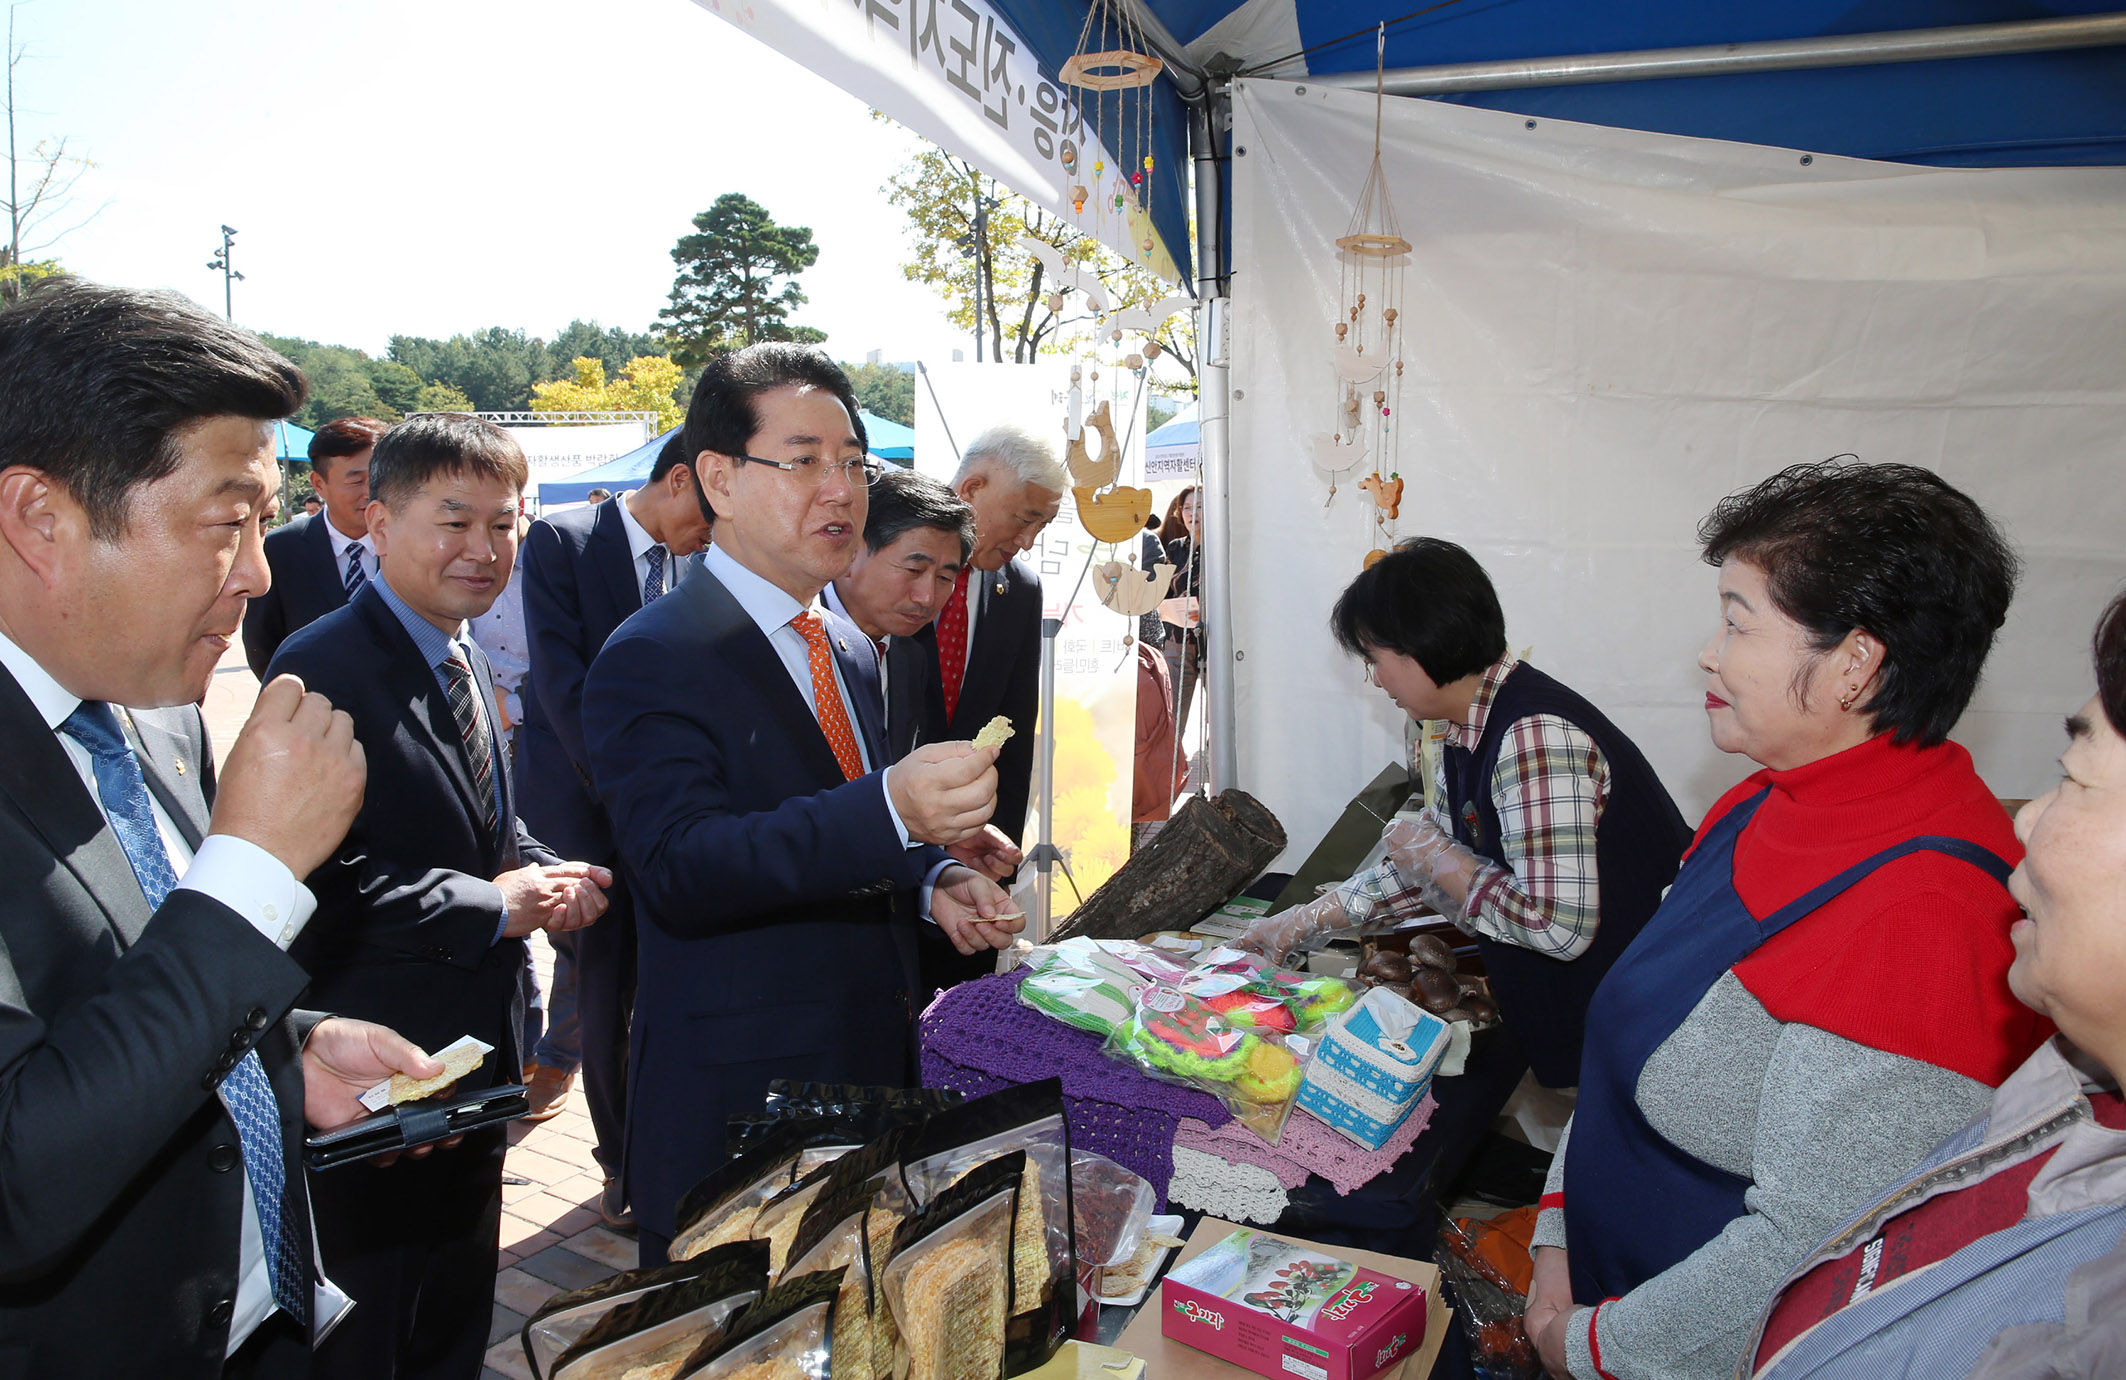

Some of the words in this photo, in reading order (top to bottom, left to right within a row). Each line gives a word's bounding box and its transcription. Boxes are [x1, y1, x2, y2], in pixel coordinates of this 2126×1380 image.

[1145, 457, 1197, 474] 신안지역자활센터
[1185, 1300, 1225, 1331] 구기자
[1321, 1288, 1374, 1321] 구기자
